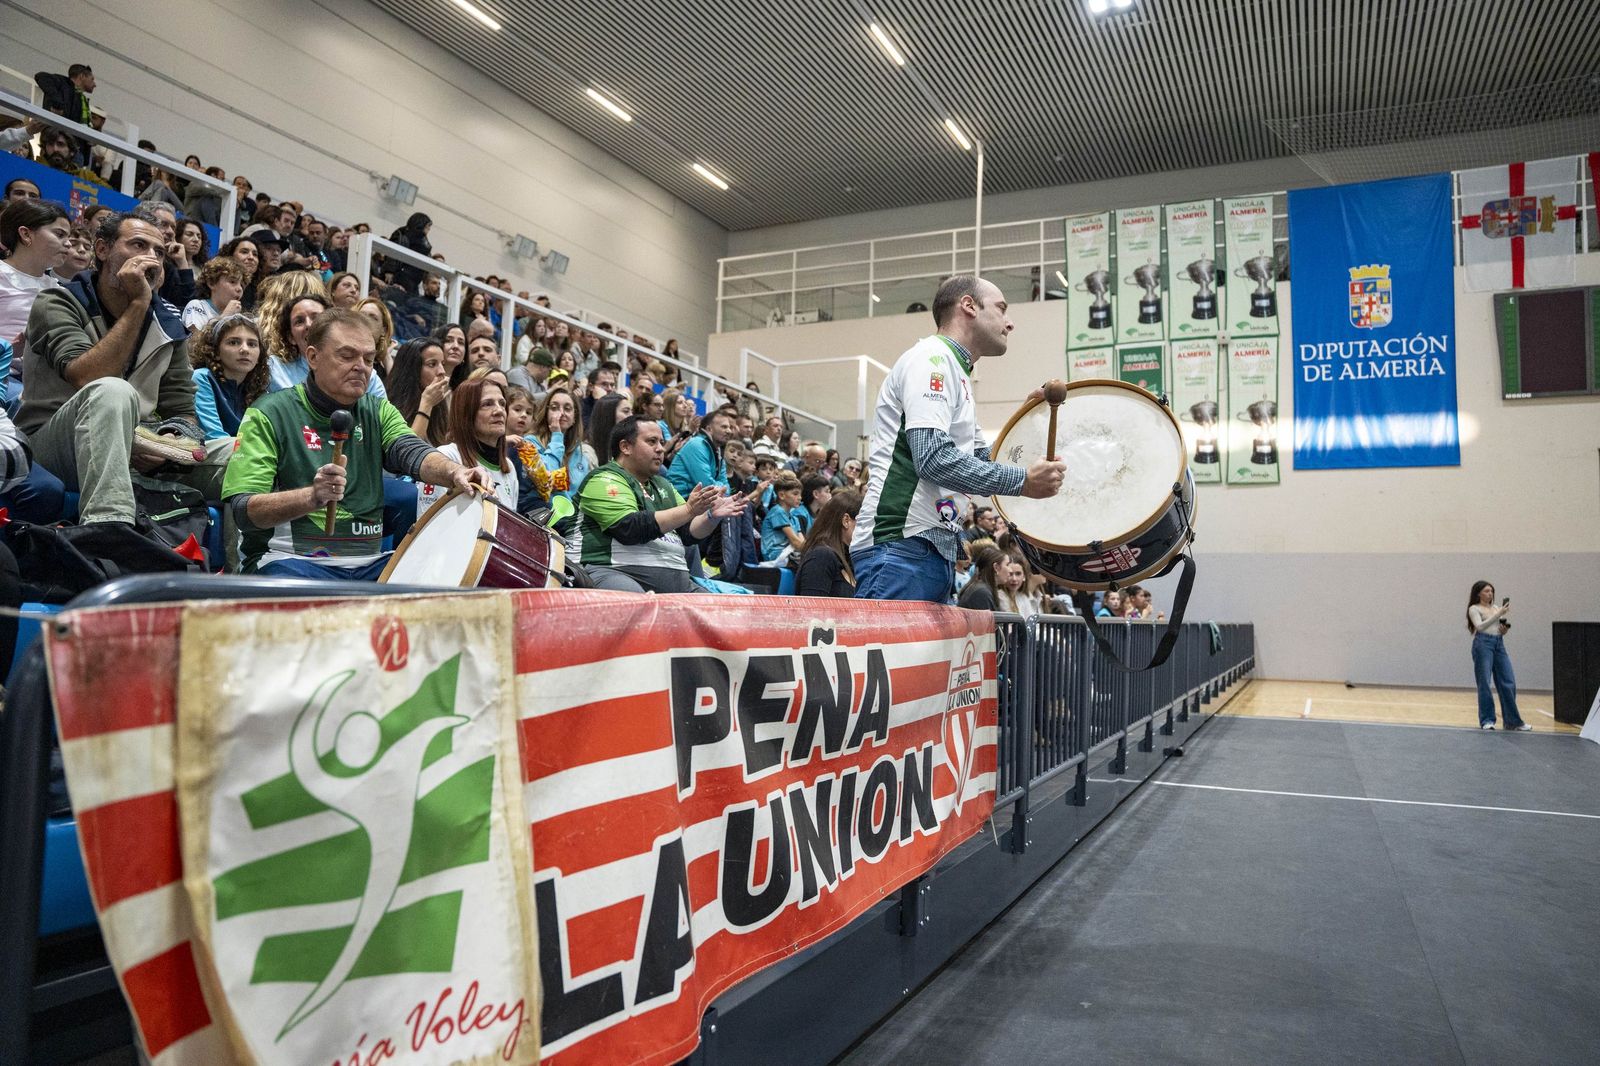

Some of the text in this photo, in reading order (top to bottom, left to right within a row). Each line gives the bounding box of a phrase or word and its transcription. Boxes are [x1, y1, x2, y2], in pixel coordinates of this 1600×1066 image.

[1299, 332, 1449, 362] DIPUTACIÓN
[1303, 354, 1446, 382] DE ALMERÍA
[668, 624, 891, 791] PEÑA
[534, 744, 939, 1047] LA UNION
[405, 980, 528, 1061] Voley
